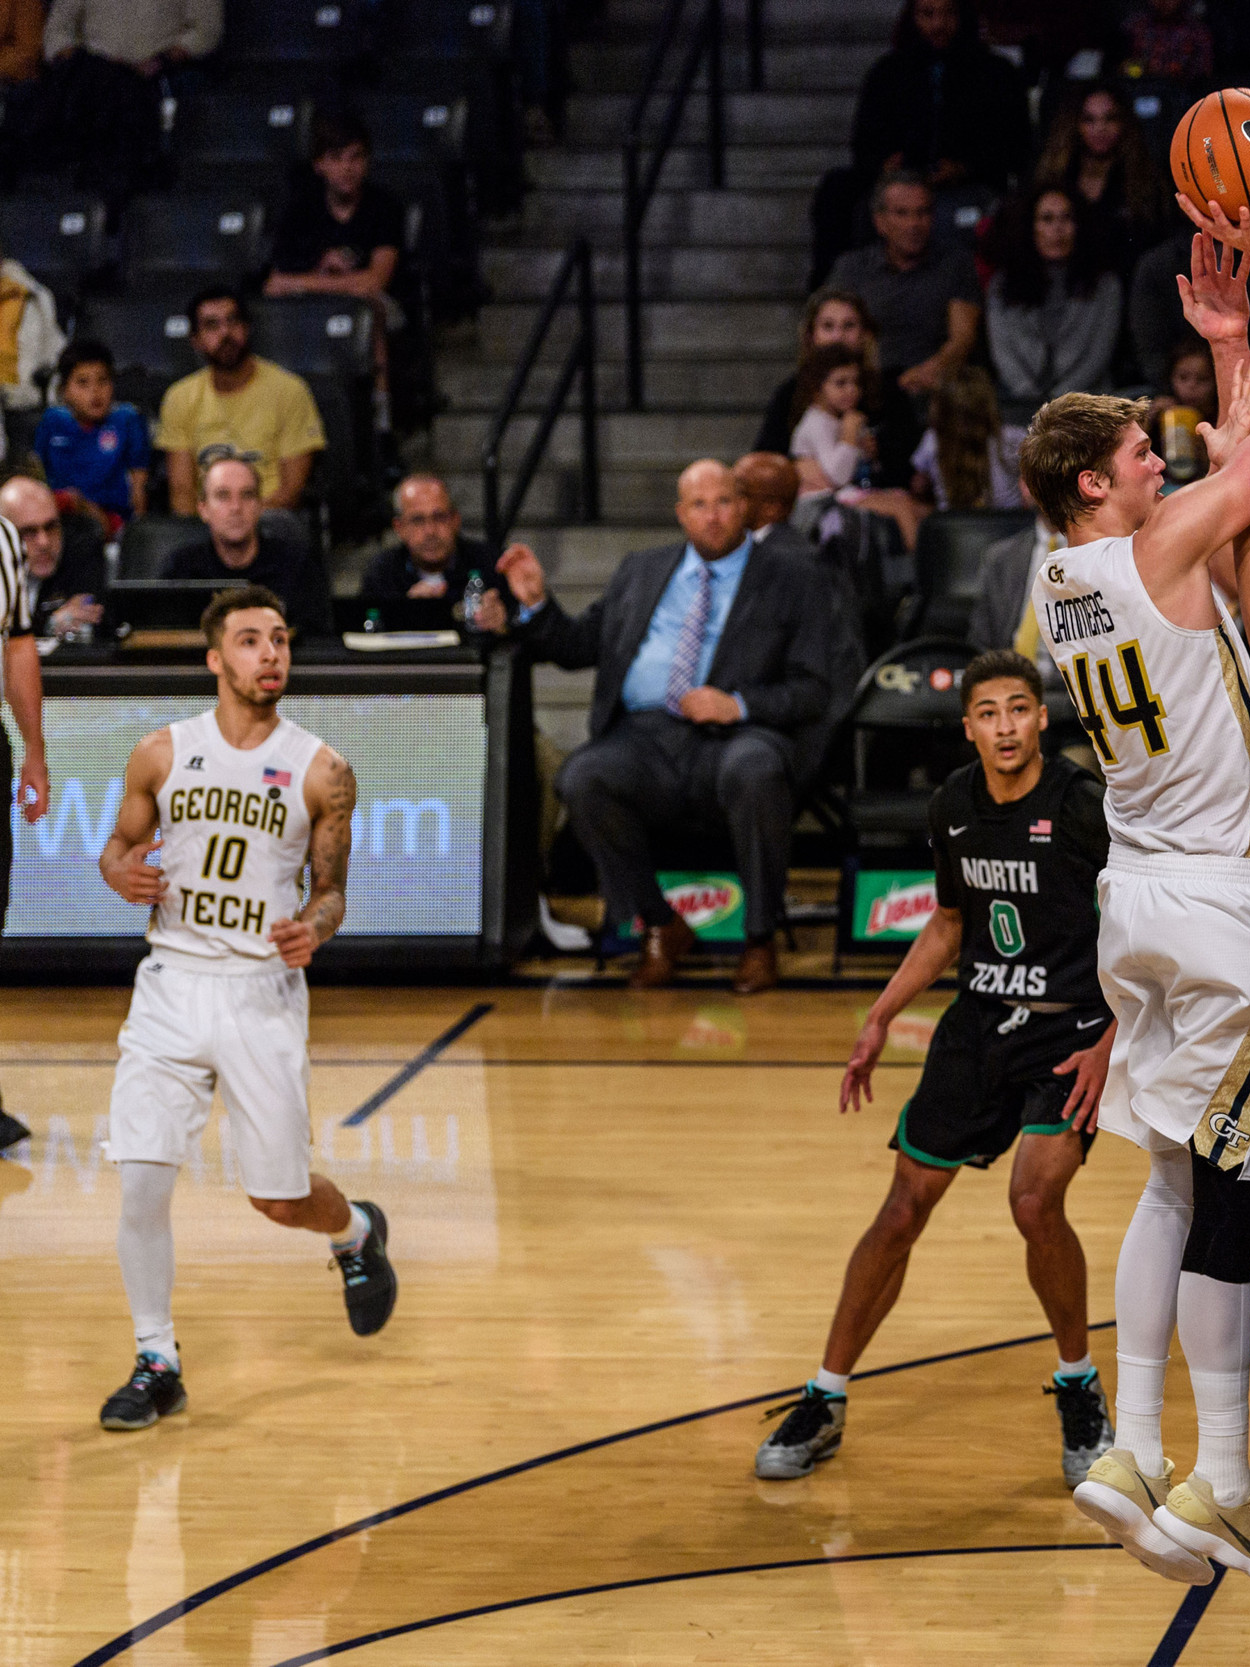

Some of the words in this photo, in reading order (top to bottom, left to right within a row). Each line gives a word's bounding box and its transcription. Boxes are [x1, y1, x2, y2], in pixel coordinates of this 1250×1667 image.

[1045, 590, 1115, 644] LAMMERS
[1058, 638, 1171, 765] 44
[170, 786, 287, 839] GEORGIA
[201, 833, 247, 882] 10
[960, 856, 1039, 894] NORTH
[180, 887, 266, 935] TECH
[988, 898, 1026, 958] 0
[968, 961, 1048, 997] TEXAS
